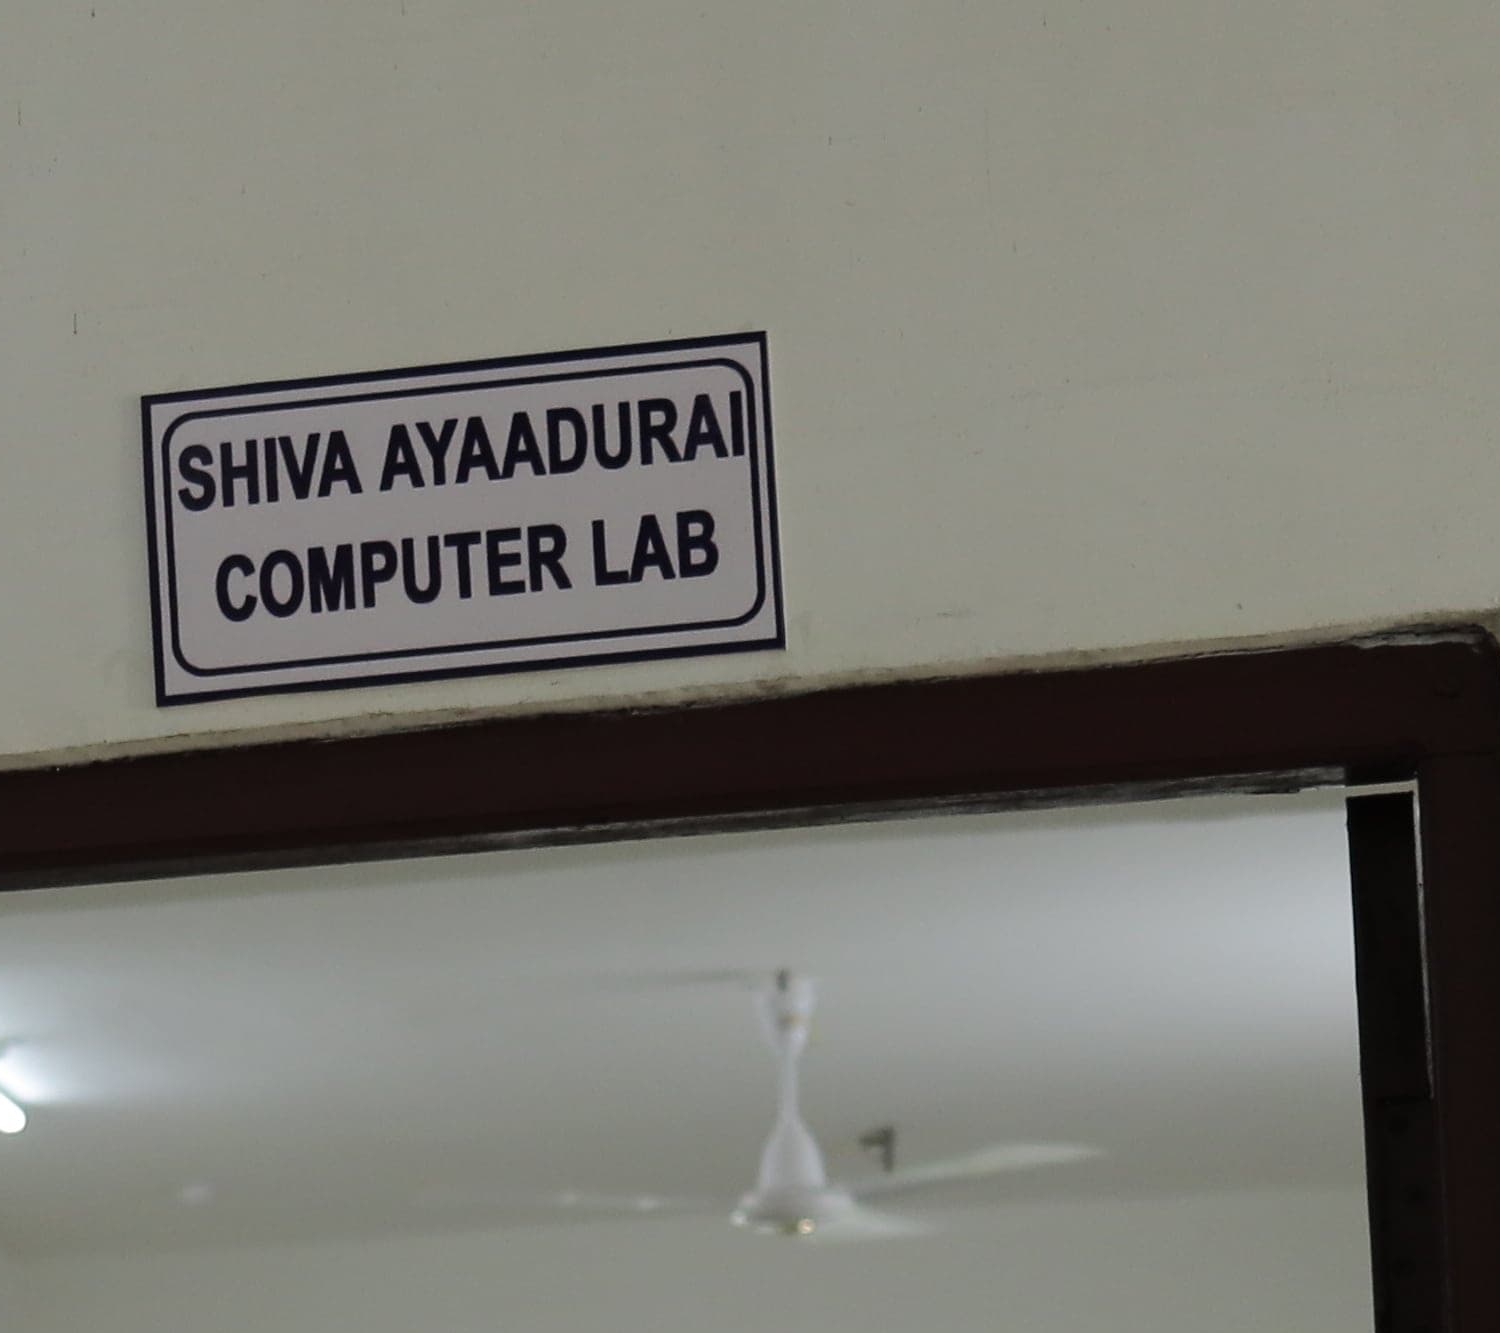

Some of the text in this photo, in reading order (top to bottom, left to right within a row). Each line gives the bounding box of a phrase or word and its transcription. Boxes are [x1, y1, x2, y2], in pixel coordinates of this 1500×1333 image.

[176, 390, 745, 512] SHIVA AYAADURAI
[215, 508, 720, 622] COMPUTER LAB
